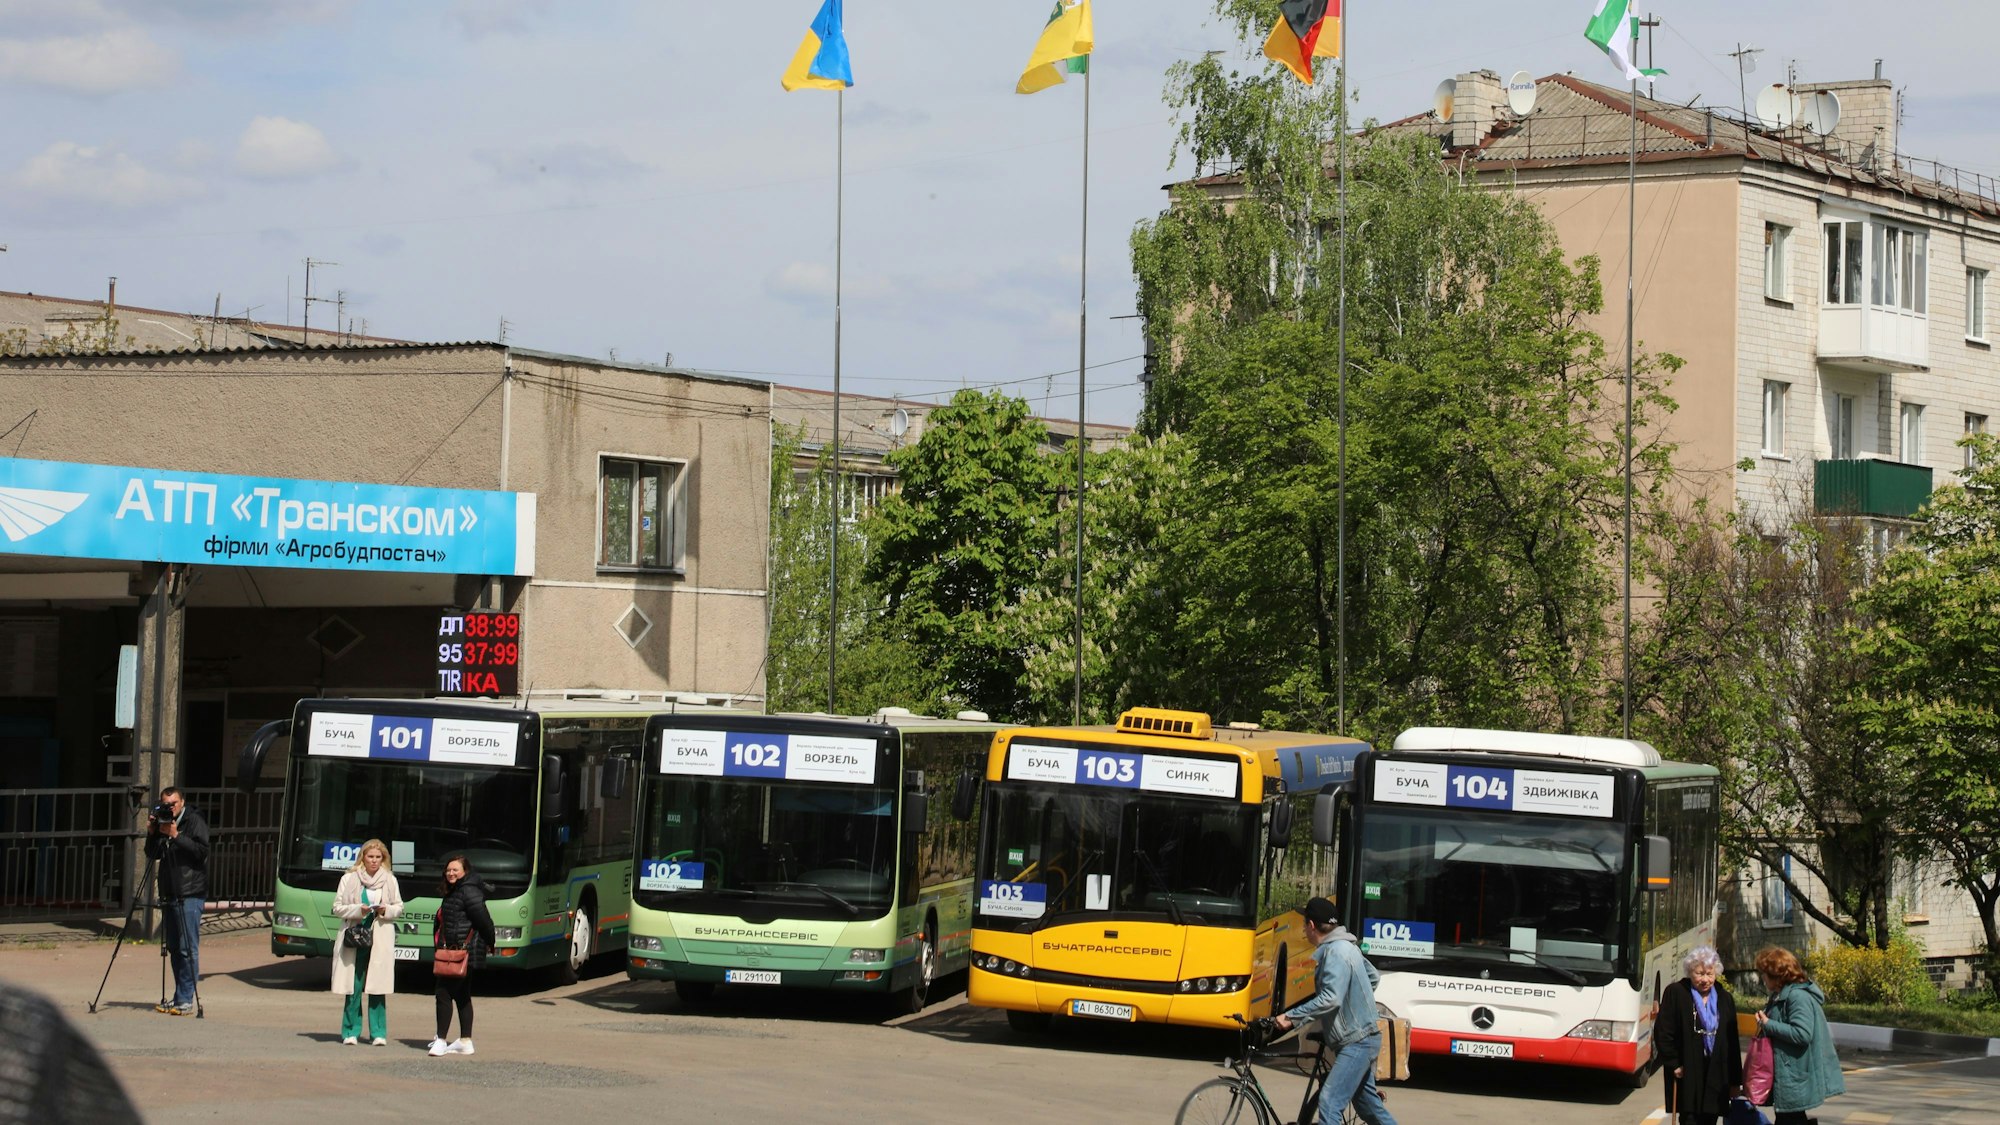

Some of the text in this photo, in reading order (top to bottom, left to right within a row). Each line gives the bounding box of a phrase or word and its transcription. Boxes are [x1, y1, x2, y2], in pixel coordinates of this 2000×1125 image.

[115, 478, 478, 540] АТП «Транском»
[204, 534, 447, 564] фірми «Агробудпостач»
[439, 614, 519, 638] ДП 38:99
[438, 641, 518, 666] 95 37:99
[438, 669, 462, 692] TIR
[324, 729, 355, 740] БУЧА
[378, 725, 424, 750] 101
[448, 736, 501, 748] ВОРЗЕЛЬ
[677, 746, 709, 757] БУЧА
[730, 743, 781, 768] 102
[804, 753, 858, 765] ВОРЗЕЛЬ
[1027, 758, 1060, 769] БУЧА
[1083, 756, 1136, 783] 103
[1166, 769, 1210, 782] СИНЯК
[1396, 777, 1430, 788] БУЧА
[1452, 774, 1508, 801] 104
[1522, 785, 1600, 801] ЗДВИЖІВКА
[1008, 851, 1023, 862] ВХІД
[648, 862, 682, 880] 102
[988, 883, 1024, 902] 103
[1365, 886, 1381, 897] ВХІД
[694, 927, 819, 941] БУЧАТРАНССЕРВІС
[1371, 922, 1412, 942] 104
[1042, 942, 1173, 957] БУЧАТРАНССЕРВІС
[1417, 979, 1557, 998] БУЧАТРАНССЕРВІС
